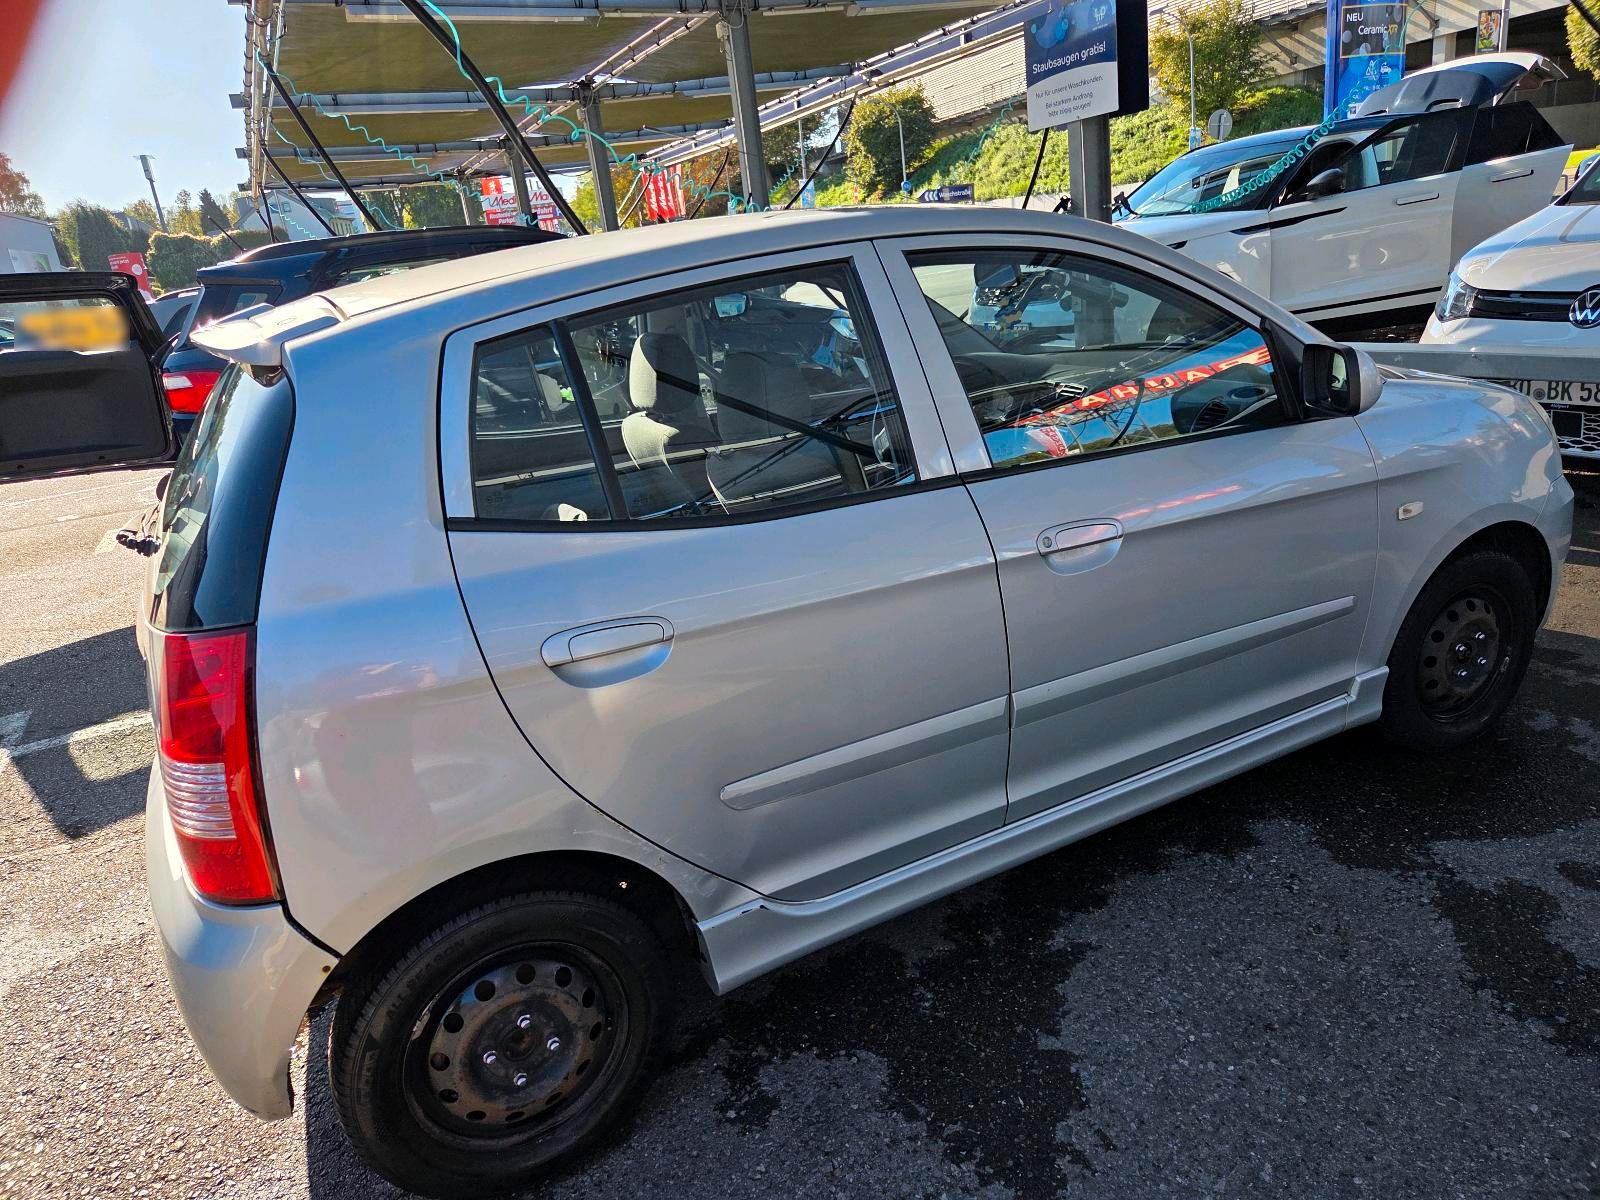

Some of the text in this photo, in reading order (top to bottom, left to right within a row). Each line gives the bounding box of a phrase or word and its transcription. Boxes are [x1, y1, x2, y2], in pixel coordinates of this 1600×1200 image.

[1346, 12, 1364, 23] NEU
[1032, 41, 1106, 75] Staubsaugen gratis!
[1051, 85, 1068, 95] unsere
[1053, 98, 1072, 107] starkem
[1072, 91, 1094, 102] Andrang
[1048, 110, 1059, 118] bitte
[1547, 381, 1573, 402] BK
